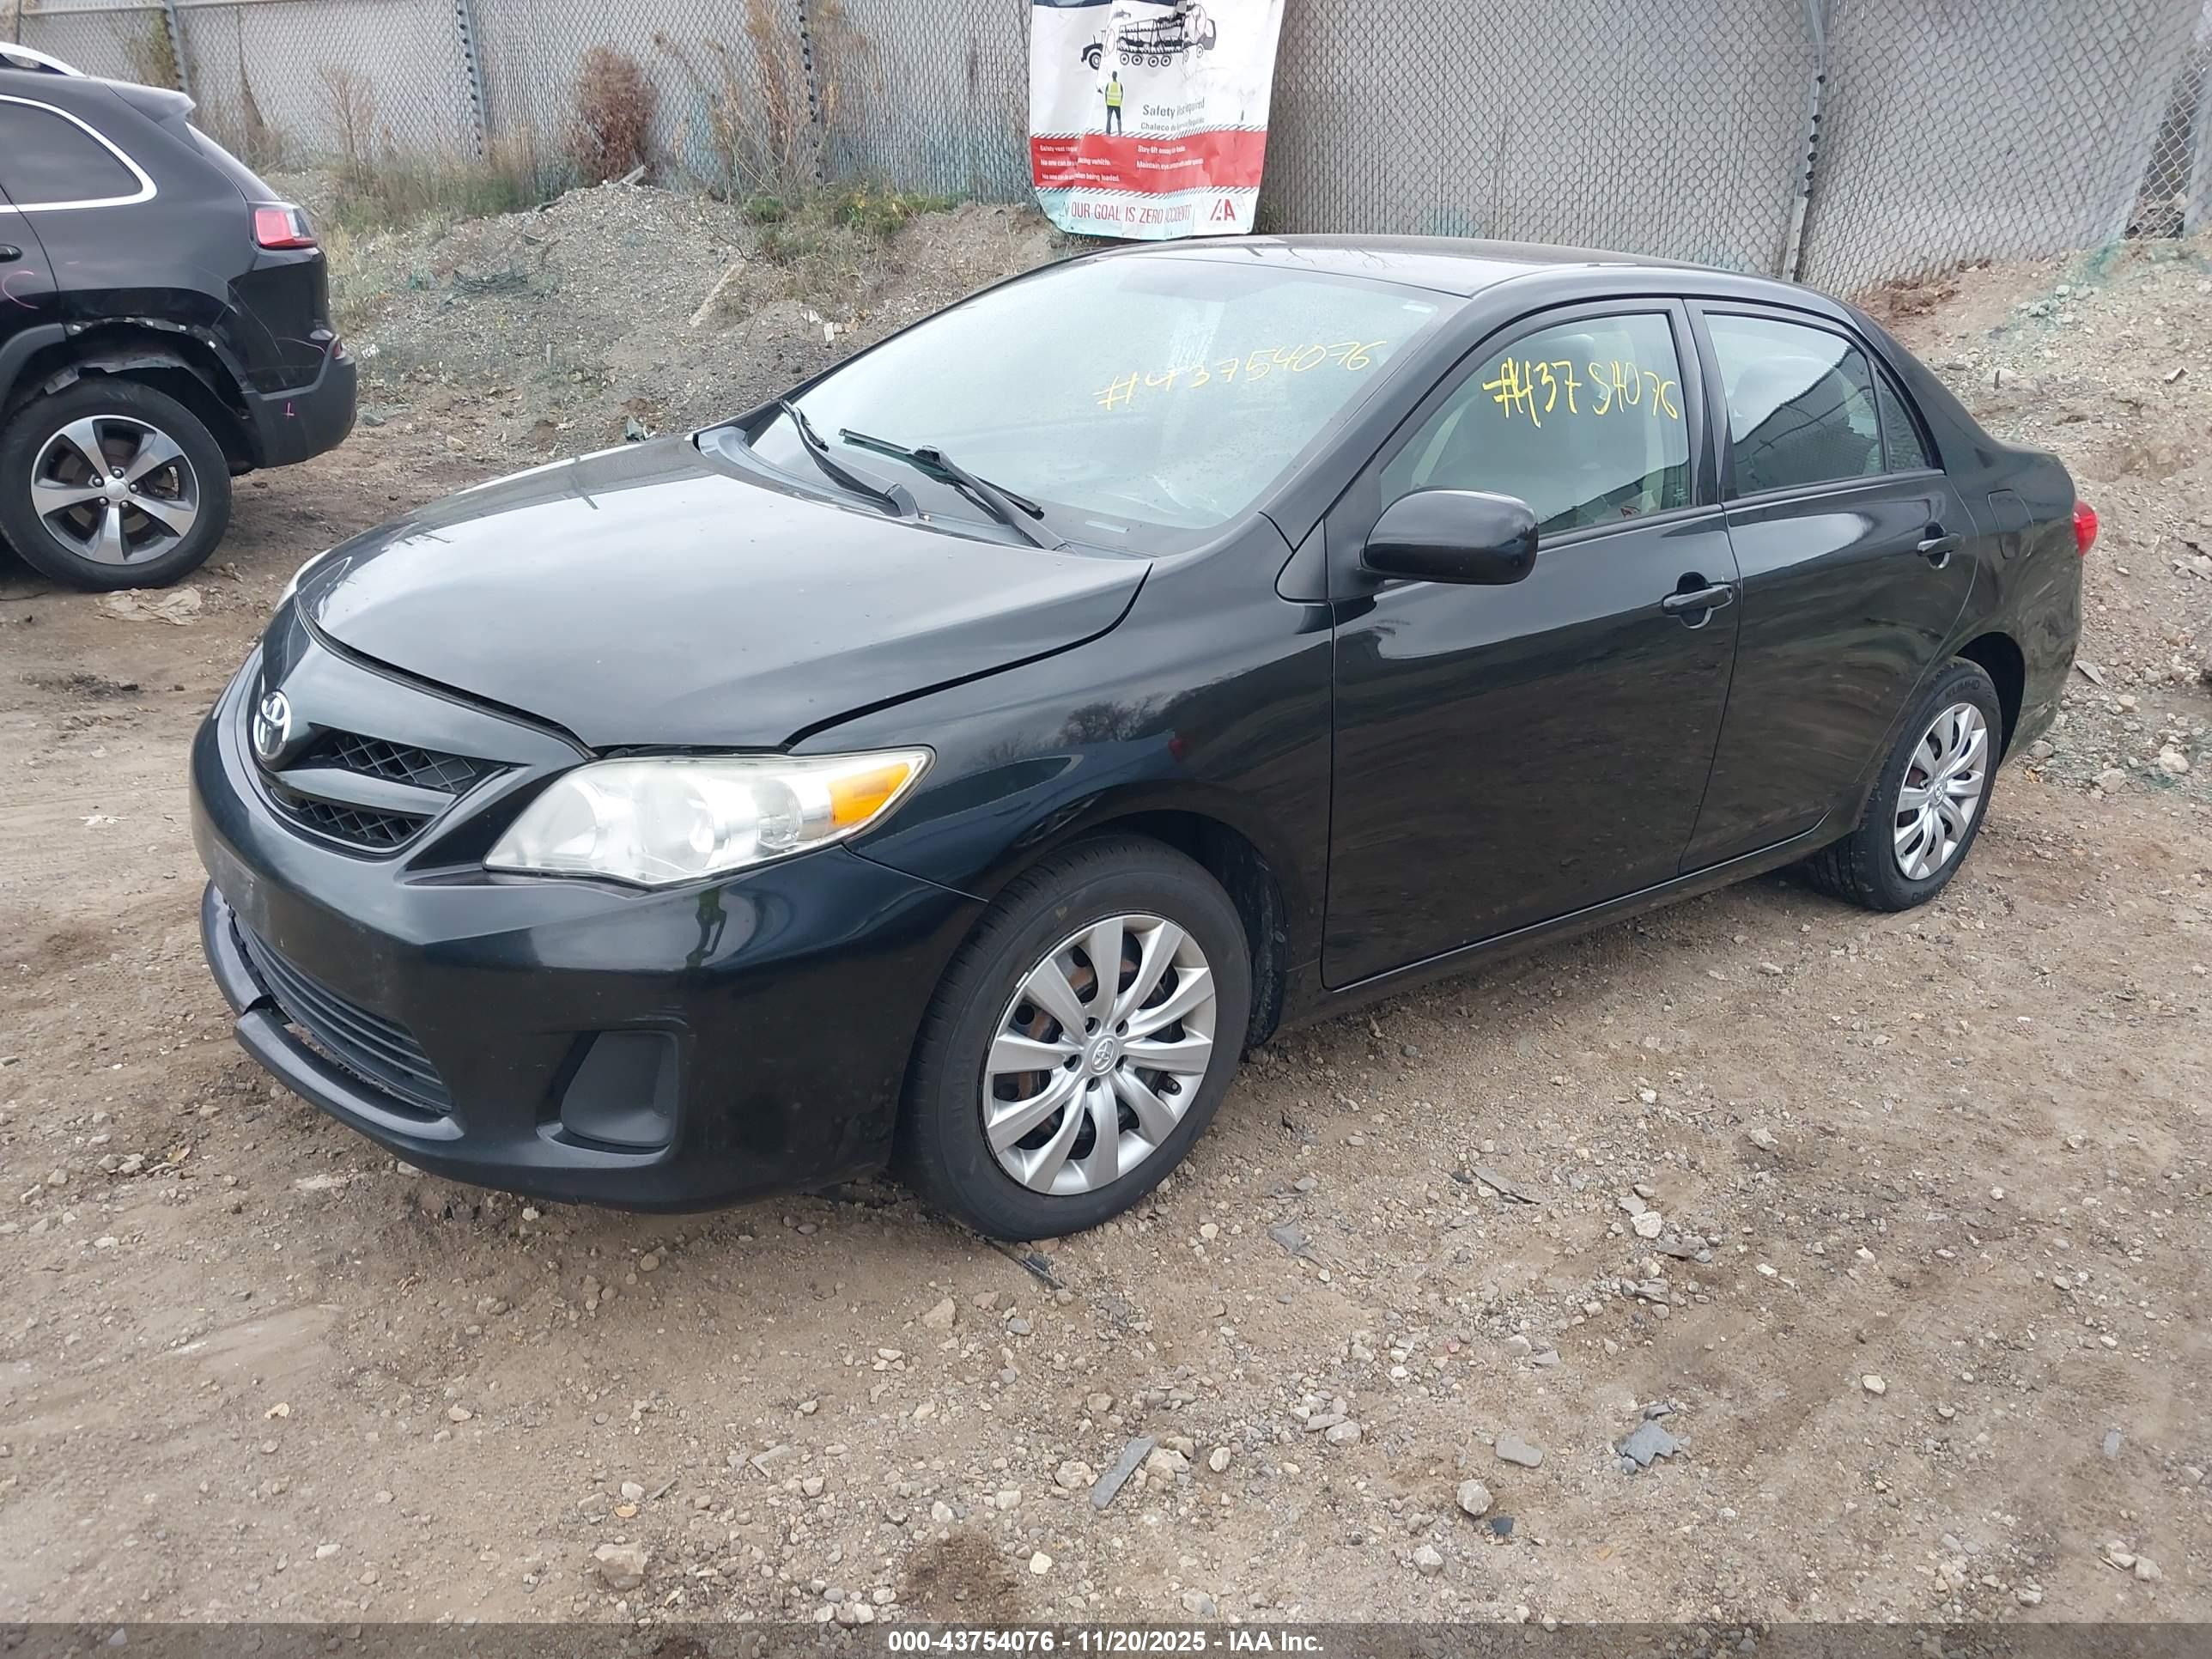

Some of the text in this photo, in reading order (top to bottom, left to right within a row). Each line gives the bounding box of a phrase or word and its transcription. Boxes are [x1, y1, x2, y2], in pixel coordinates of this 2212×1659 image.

[1143, 104, 1176, 119] Safety
[1140, 122, 1170, 131] Chaleco
[1071, 201, 1091, 219] OUR
[1094, 203, 1121, 222] GOAL
[1125, 206, 1136, 222] IS
[1139, 207, 1164, 224] ZERO
